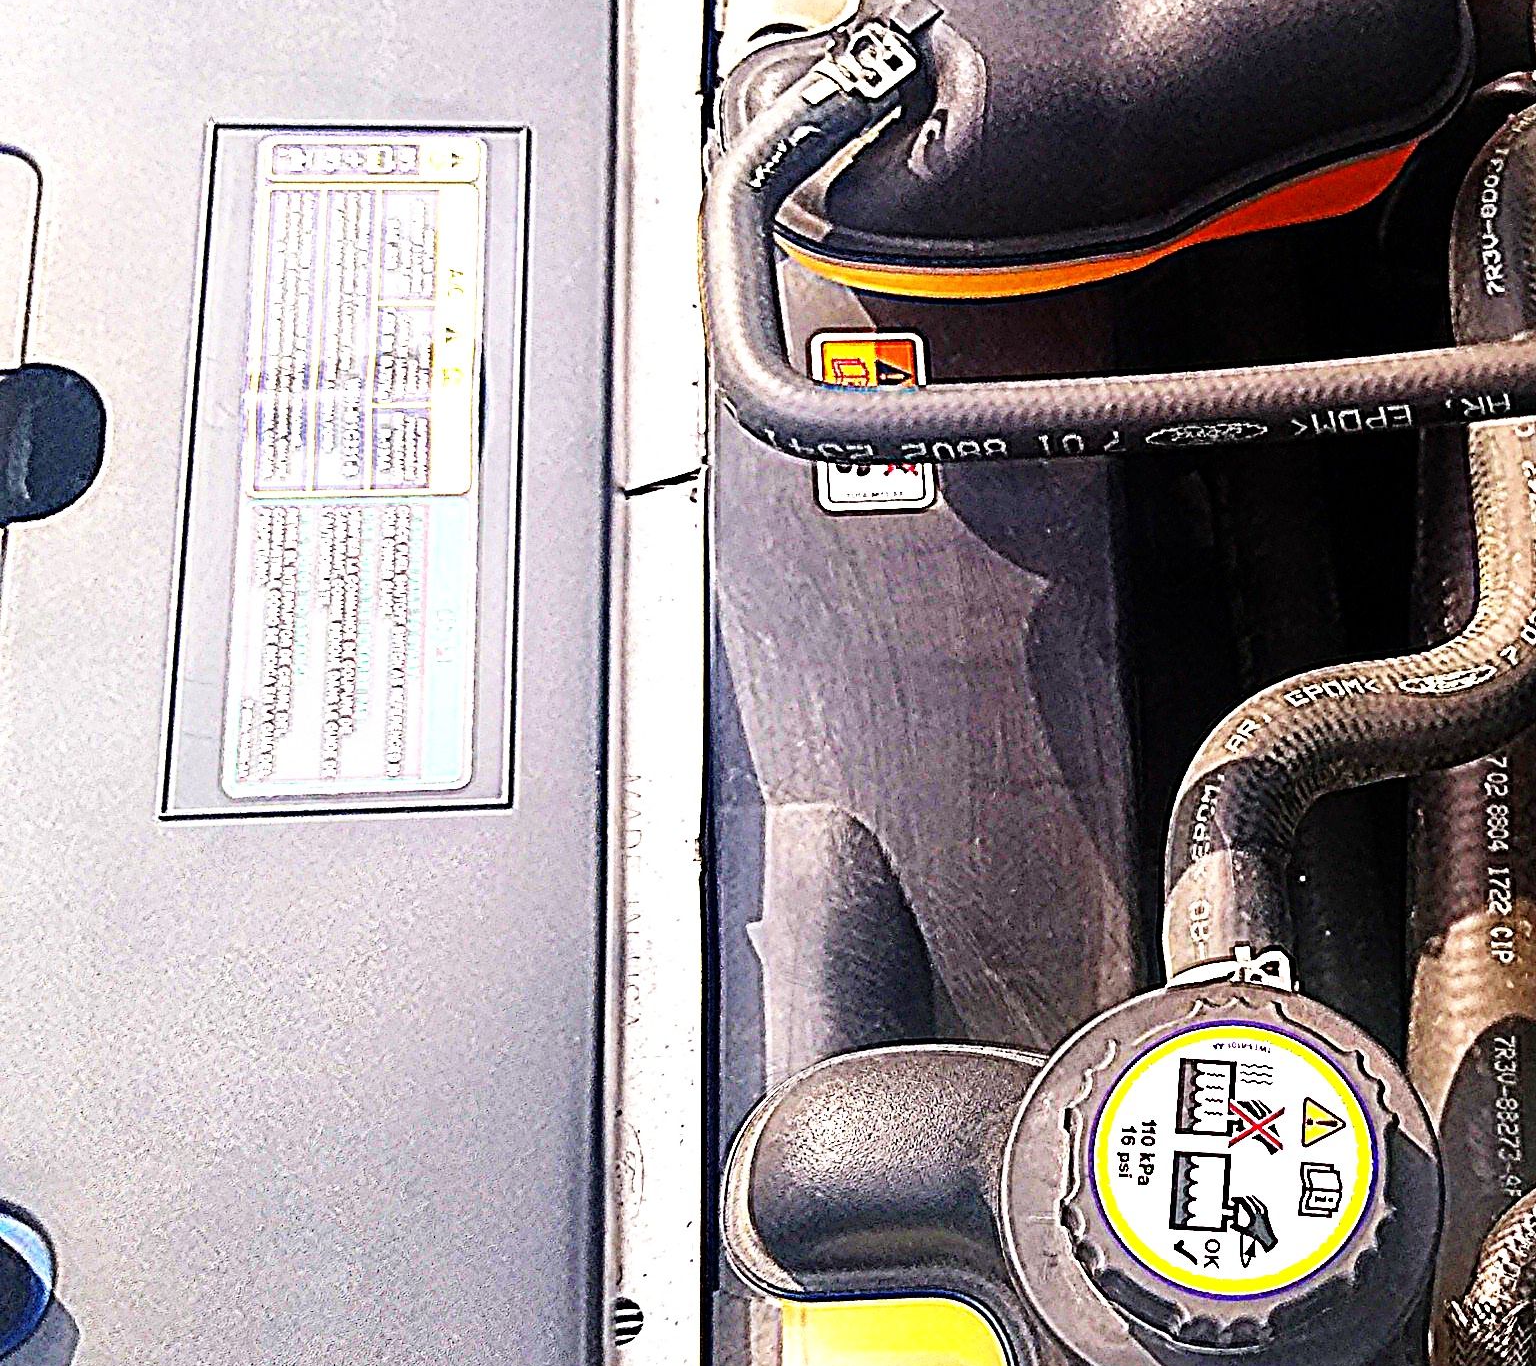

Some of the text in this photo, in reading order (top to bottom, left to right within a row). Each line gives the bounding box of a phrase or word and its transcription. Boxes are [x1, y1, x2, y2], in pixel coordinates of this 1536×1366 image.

[1484, 772, 1508, 796] 02
[1486, 804, 1509, 852] 8804
[1487, 867, 1513, 915] 1722
[1489, 926, 1515, 964] CIP
[1117, 1126, 1138, 1179] 16 psi
[1137, 1119, 1157, 1186] 110 kPa
[1203, 1239, 1221, 1269] OK
